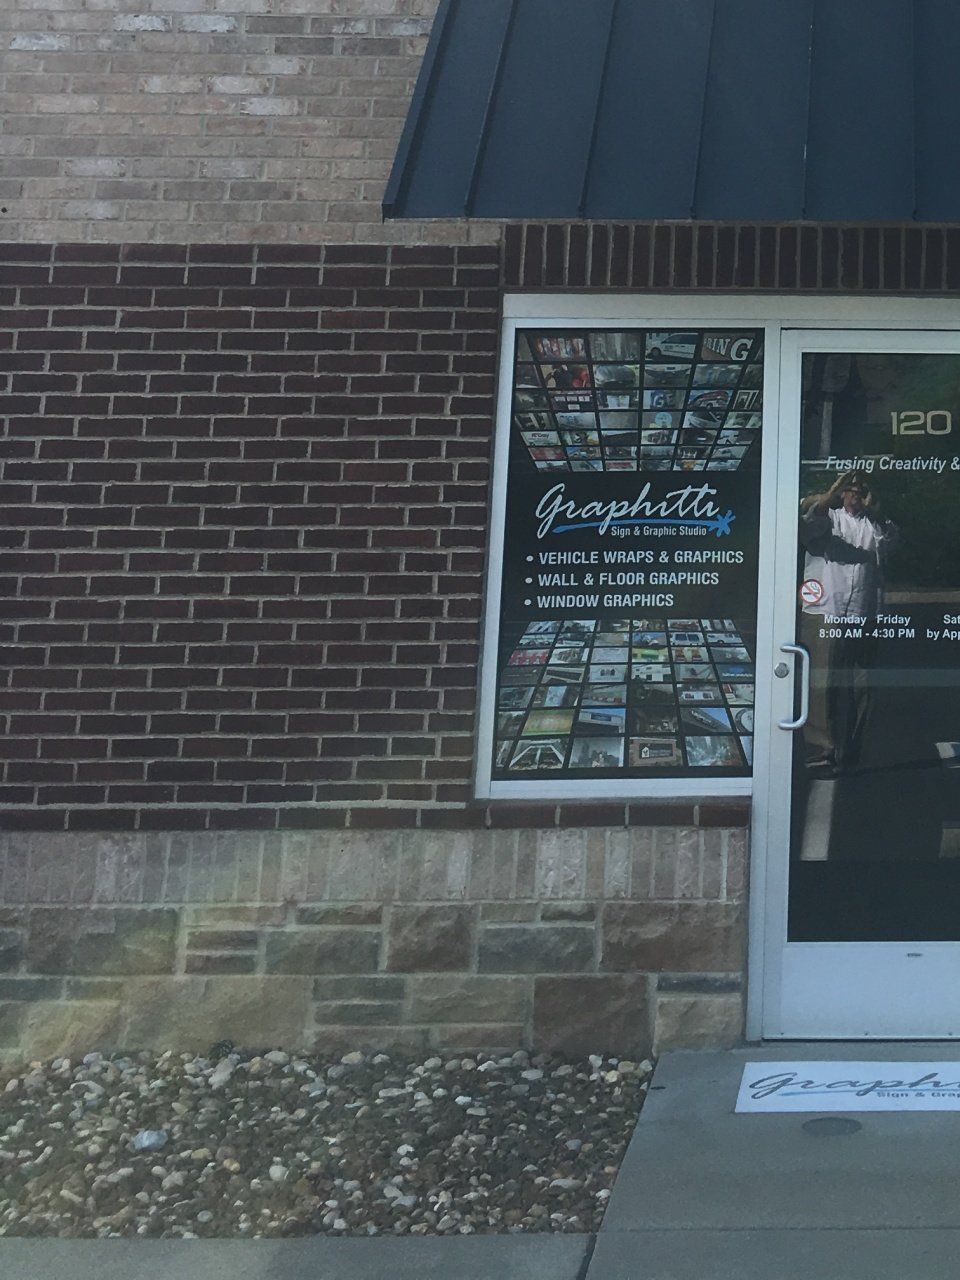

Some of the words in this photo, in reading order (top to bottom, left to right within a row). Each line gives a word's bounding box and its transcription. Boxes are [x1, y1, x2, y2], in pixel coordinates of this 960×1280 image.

[890, 410, 952, 436] 120
[826, 455, 875, 474] Fusing
[879, 456, 947, 474] Creativity
[950, 457, 960, 471] &
[535, 482, 720, 539] Graphitti
[611, 526, 631, 539] Sign
[633, 526, 641, 536] &
[643, 526, 677, 538] Graphic
[679, 526, 707, 536] Studio
[539, 551, 599, 565] VEHICLE
[603, 551, 654, 564] WRAPS
[659, 552, 669, 563] &
[674, 551, 744, 564] GRAPHICS
[538, 573, 579, 587] WALL
[583, 574, 594, 586] &
[599, 573, 645, 586] FLOOR
[649, 573, 720, 585] GRAPHICS
[537, 595, 599, 609] WINDOW
[603, 594, 674, 607] GRAPHICS
[824, 614, 867, 625] Monday
[876, 614, 911, 625] Friday
[819, 628, 842, 639] 8:00
[844, 628, 862, 639] AM
[871, 628, 895, 639] 4:30
[898, 628, 915, 639] PM
[926, 628, 940, 641] by
[877, 1091, 909, 1099] Sign
